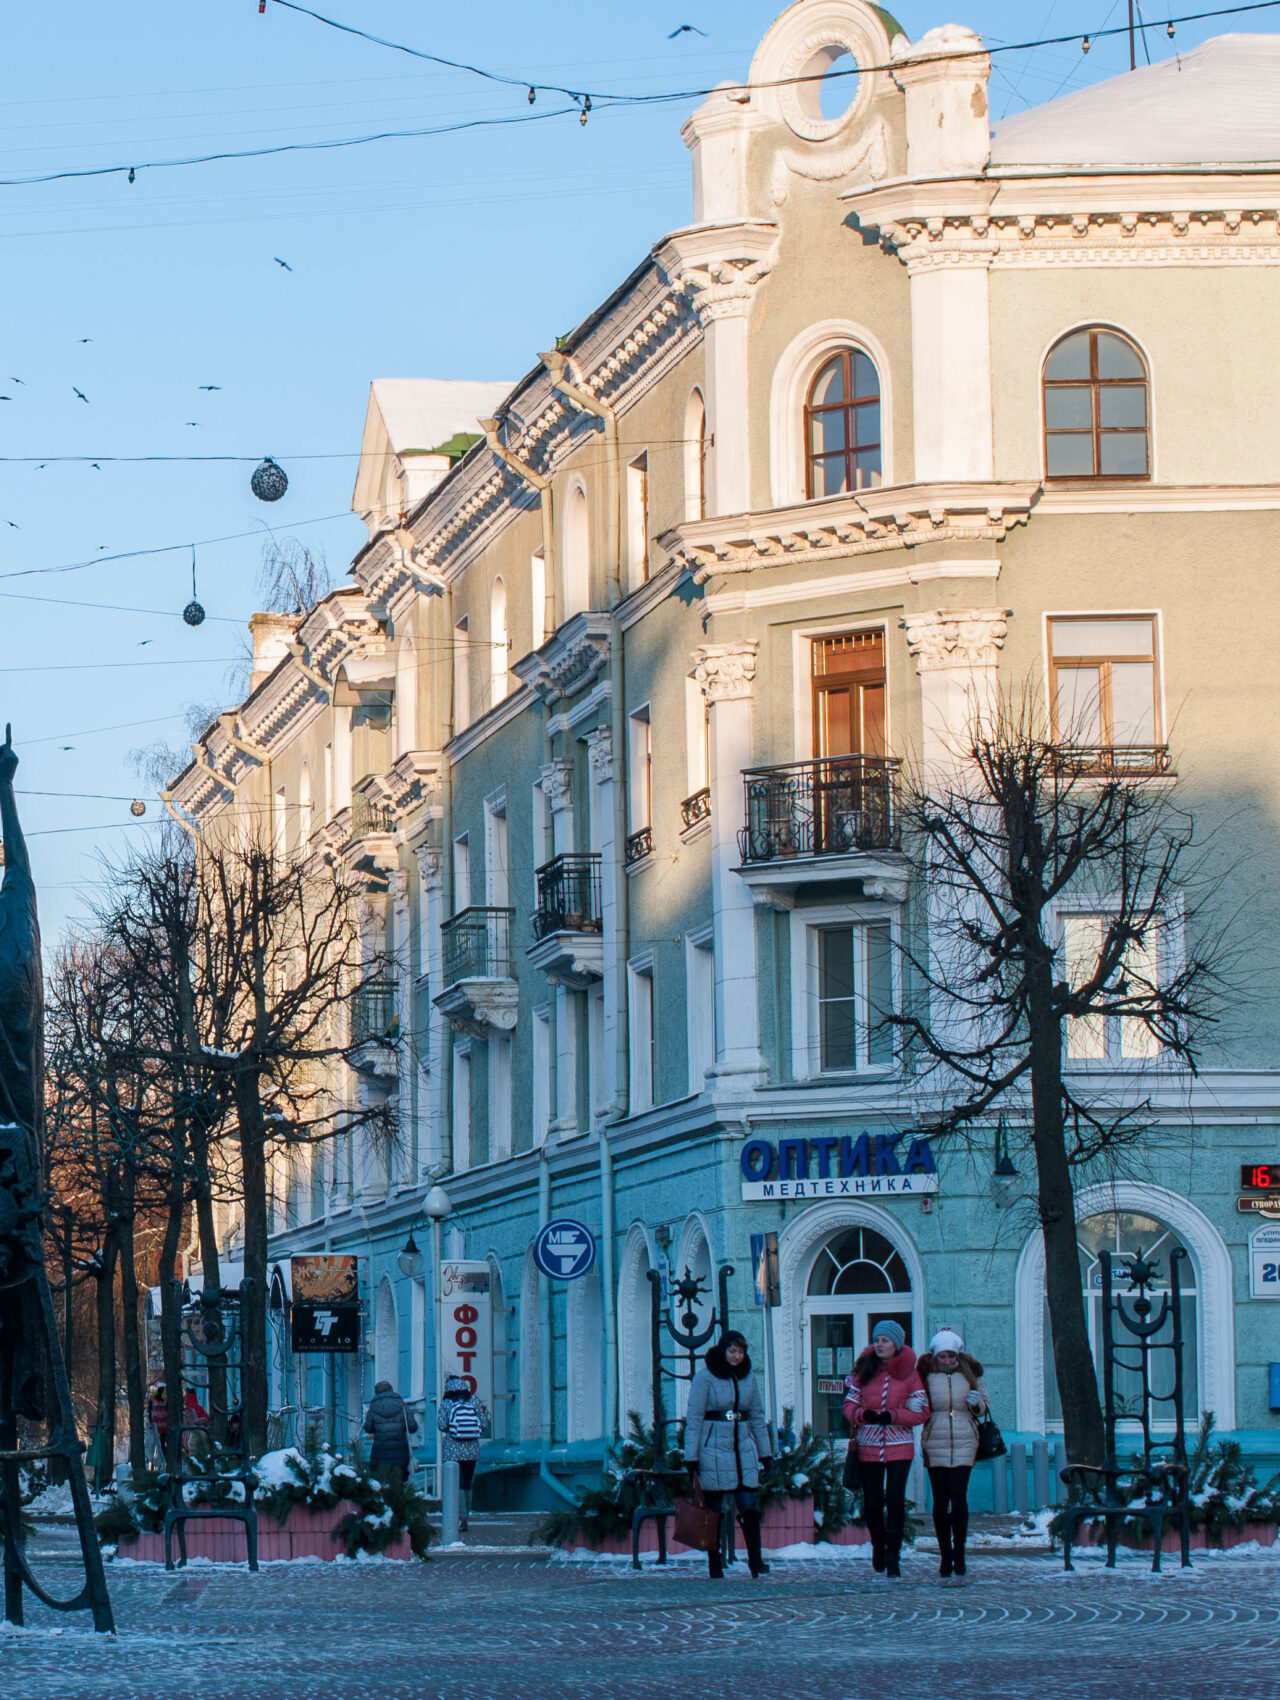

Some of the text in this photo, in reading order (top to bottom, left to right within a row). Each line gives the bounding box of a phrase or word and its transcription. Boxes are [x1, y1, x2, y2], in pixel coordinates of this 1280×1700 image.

[741, 1133, 937, 1182] ОПТИКА
[763, 1178, 912, 1198] МЕДТЕХНИКА
[1262, 1262, 1280, 1283] 2
